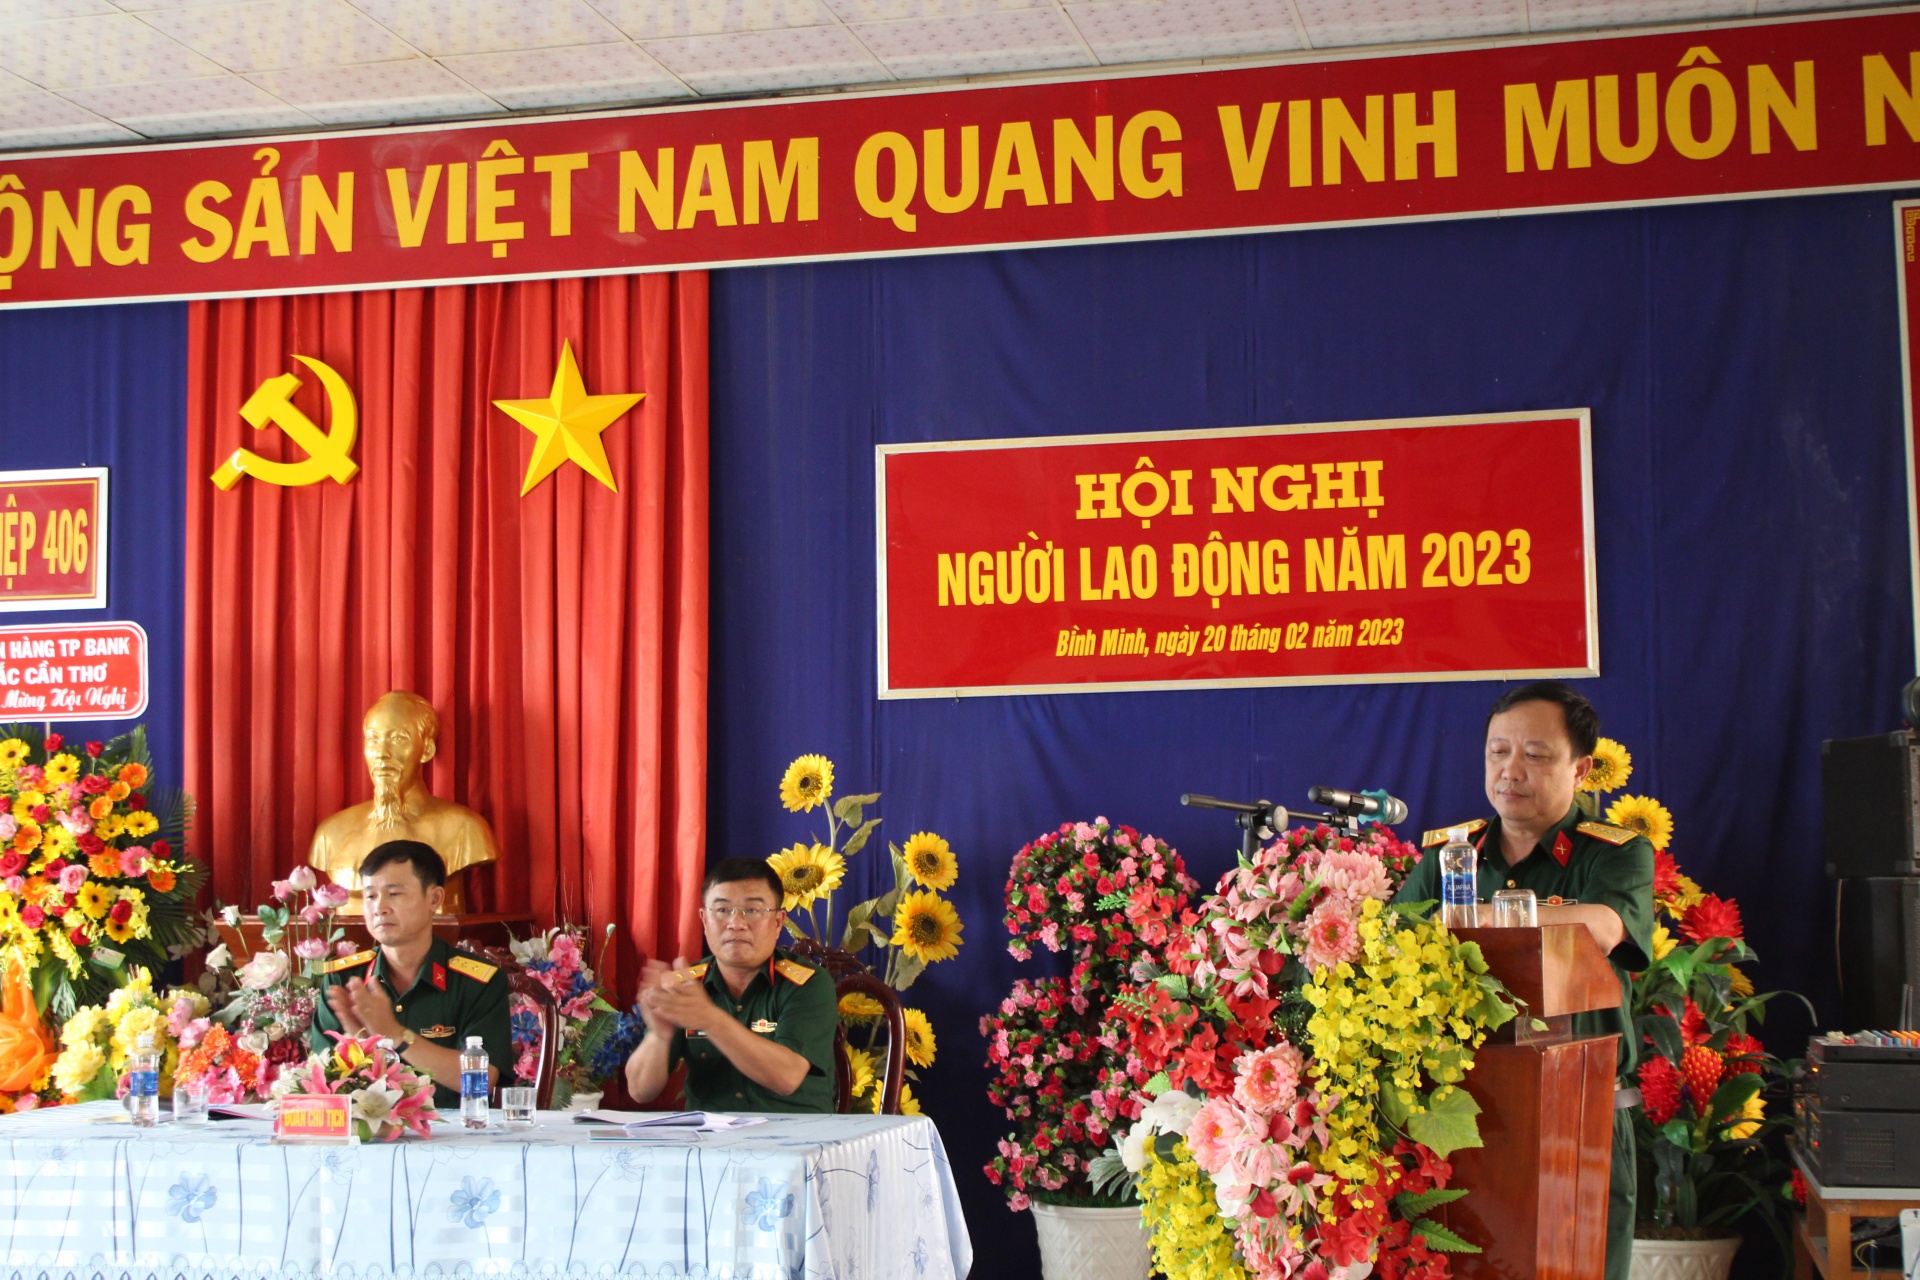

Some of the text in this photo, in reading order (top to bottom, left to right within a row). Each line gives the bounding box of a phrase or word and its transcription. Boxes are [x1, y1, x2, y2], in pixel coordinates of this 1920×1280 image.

[181, 147, 355, 264] SẢN
[386, 139, 589, 259] VIỆT
[618, 137, 819, 233] NAM
[854, 110, 1183, 233] QUANG
[1217, 89, 1458, 191] VINH
[1503, 46, 1818, 173] MUÔN
[1075, 456, 1385, 529] HỘI NGHỊ
[42, 508, 88, 574] 406
[937, 526, 1531, 609] NGƯỜI LAO ĐỘNG NĂM 2023
[10, 636, 55, 659] HÀNG
[58, 638, 80, 657] TP
[85, 637, 130, 656] BANK
[1055, 618, 1405, 657] Bình Minh, ngày 20 tháng 02 năm 2023
[24, 660, 63, 684] CẦN
[67, 662, 108, 683] THƠ
[2, 689, 47, 711] Mừng
[85, 686, 127, 710] Nghị
